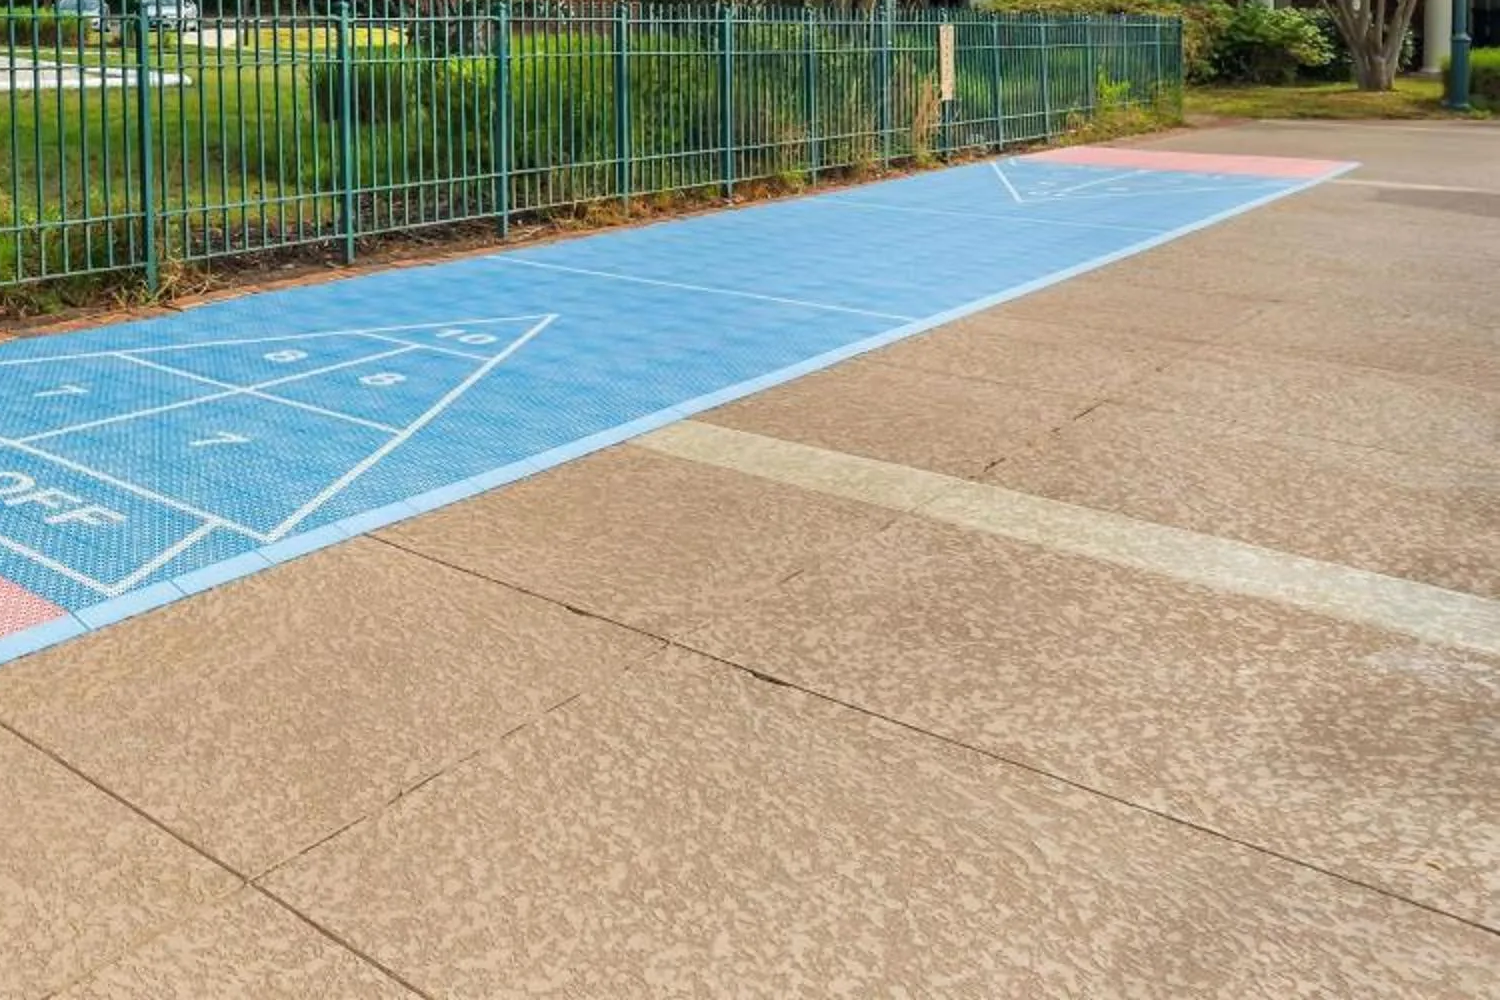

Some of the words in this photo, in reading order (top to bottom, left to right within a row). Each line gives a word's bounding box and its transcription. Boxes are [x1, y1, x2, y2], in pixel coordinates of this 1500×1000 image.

[264, 349, 308, 365] 8
[358, 371, 407, 387] 8
[188, 430, 254, 447] 7
